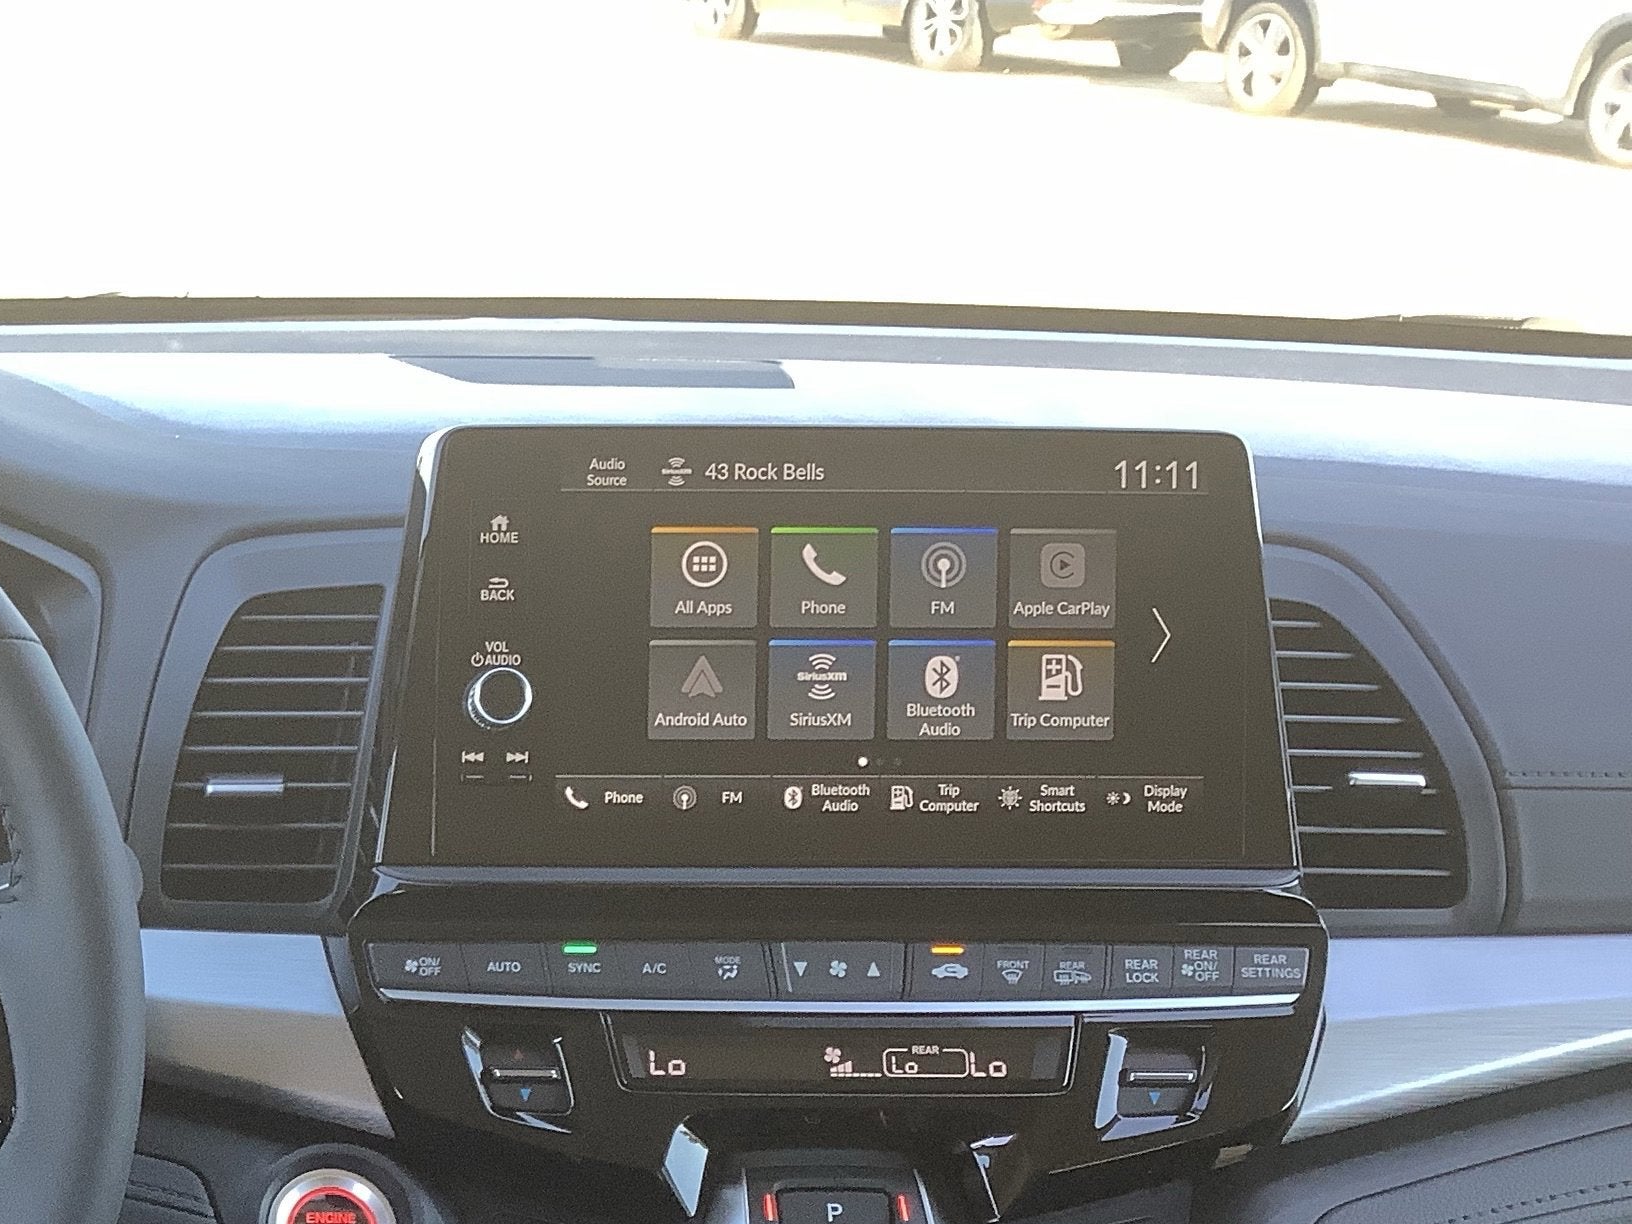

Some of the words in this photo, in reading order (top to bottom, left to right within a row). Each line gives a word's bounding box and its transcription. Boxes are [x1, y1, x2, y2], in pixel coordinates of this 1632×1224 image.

[589, 458, 626, 471] Audio
[705, 463, 729, 481] 43
[734, 462, 778, 481] Rock
[782, 462, 825, 481] Bells
[1114, 460, 1200, 490] 11:11
[586, 474, 627, 487] Source
[480, 531, 519, 544] HOME
[480, 588, 515, 601] BACK
[674, 601, 693, 615] All
[697, 602, 732, 617] Apps
[800, 601, 846, 615] Phone
[930, 602, 955, 615] FM
[1013, 602, 1054, 618] Apple
[1056, 602, 1110, 618] CarPlay
[485, 641, 509, 653] VOL
[485, 653, 521, 667] AUDIO
[906, 703, 976, 718] Bluetooth
[654, 712, 709, 727] Android
[713, 712, 748, 727] Auto
[789, 712, 852, 727] SiriusXM
[1011, 713, 1037, 729] Trip
[1040, 714, 1110, 729] Computer
[919, 723, 961, 737] Audio
[810, 784, 871, 797] Bluetooth
[938, 784, 960, 798] Trip
[1040, 784, 1076, 797] Smart
[1144, 784, 1188, 799] Display
[604, 791, 644, 804] Phone
[722, 792, 743, 804] FM
[822, 800, 859, 812] Audio
[919, 800, 980, 814] Computer
[1029, 800, 1087, 813] Shortcuts
[1147, 800, 1183, 813] Mode
[419, 956, 441, 967] ON/
[714, 956, 741, 965] MODE
[1184, 949, 1218, 961] REAR
[1253, 953, 1288, 966] REAR
[419, 966, 441, 977] OFF
[487, 961, 521, 973] AUTO
[568, 962, 602, 974] SYNC
[642, 963, 667, 975] A/C
[996, 960, 1029, 970] FRONT
[1059, 961, 1086, 970] REAR
[1125, 959, 1159, 971] REAR
[1194, 960, 1219, 972] ON/
[1125, 972, 1159, 984] LOCK
[1195, 970, 1220, 982] OFF
[1241, 966, 1302, 980] SETTINGS
[911, 1045, 940, 1055] REAR
[306, 1212, 356, 1224] ENGINE
[827, 1203, 843, 1222] P
